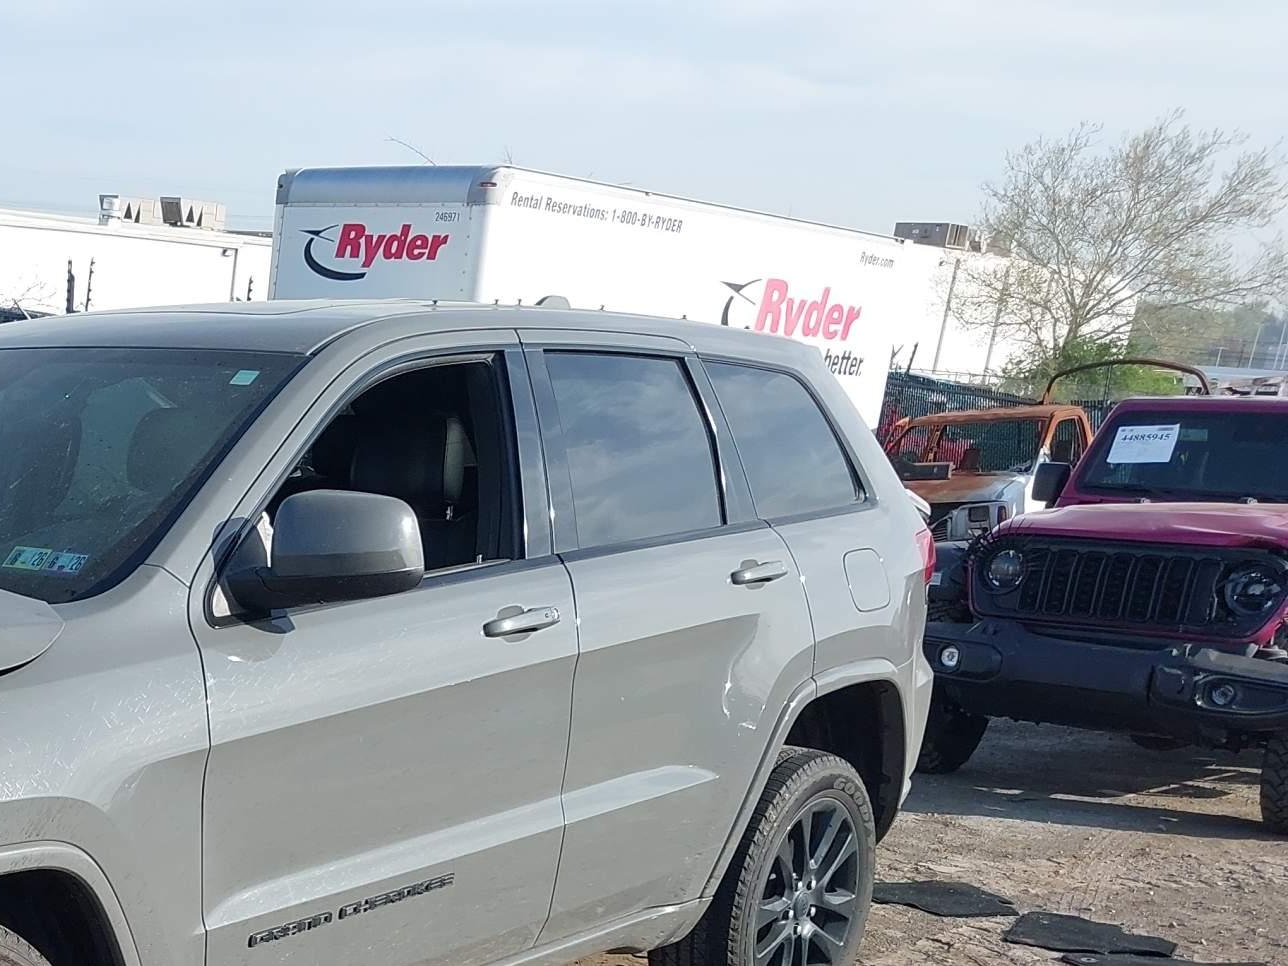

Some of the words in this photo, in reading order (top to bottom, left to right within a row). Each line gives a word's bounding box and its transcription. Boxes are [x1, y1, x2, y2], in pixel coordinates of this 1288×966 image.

[434, 211, 461, 223] 246971
[511, 191, 542, 211] Rental
[545, 197, 609, 222] Reservations:
[611, 208, 683, 234] 1-800-BY-RYDER
[334, 223, 450, 268] Ryder
[860, 252, 895, 268] Ryder.com
[754, 277, 863, 341] Ryder
[1121, 433, 1172, 441] 44885945
